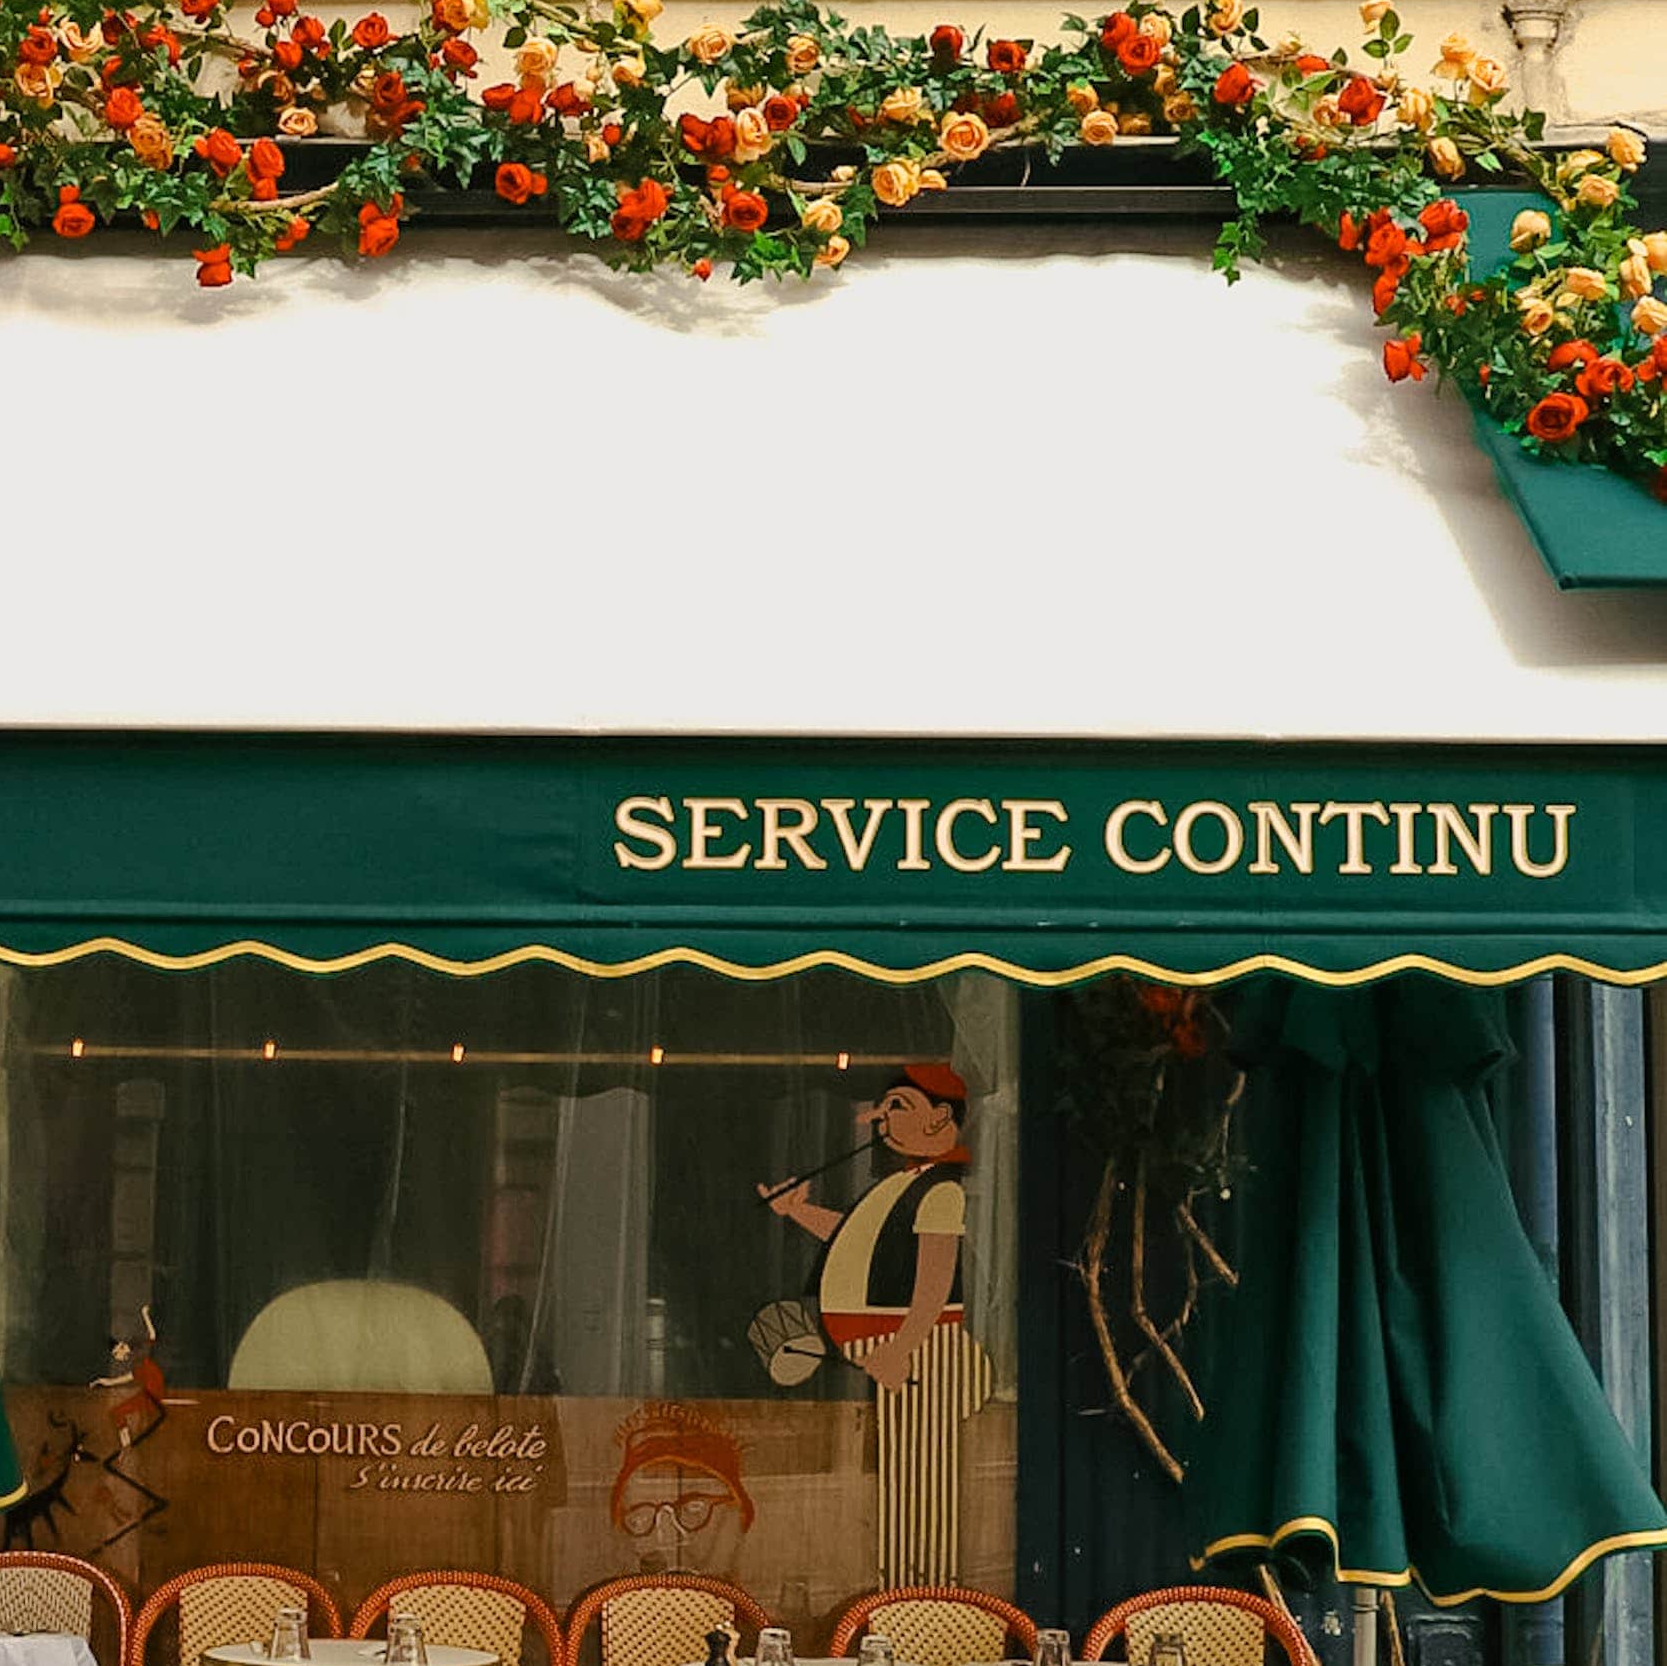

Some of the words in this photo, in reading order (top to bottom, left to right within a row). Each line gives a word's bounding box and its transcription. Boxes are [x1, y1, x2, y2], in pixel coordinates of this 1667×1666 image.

[613, 795, 1073, 873] SERVICE
[1103, 799, 1577, 879] CONTINU
[410, 1424, 447, 1458] de
[453, 1423, 548, 1460] belote
[494, 1465, 544, 1493] ici
